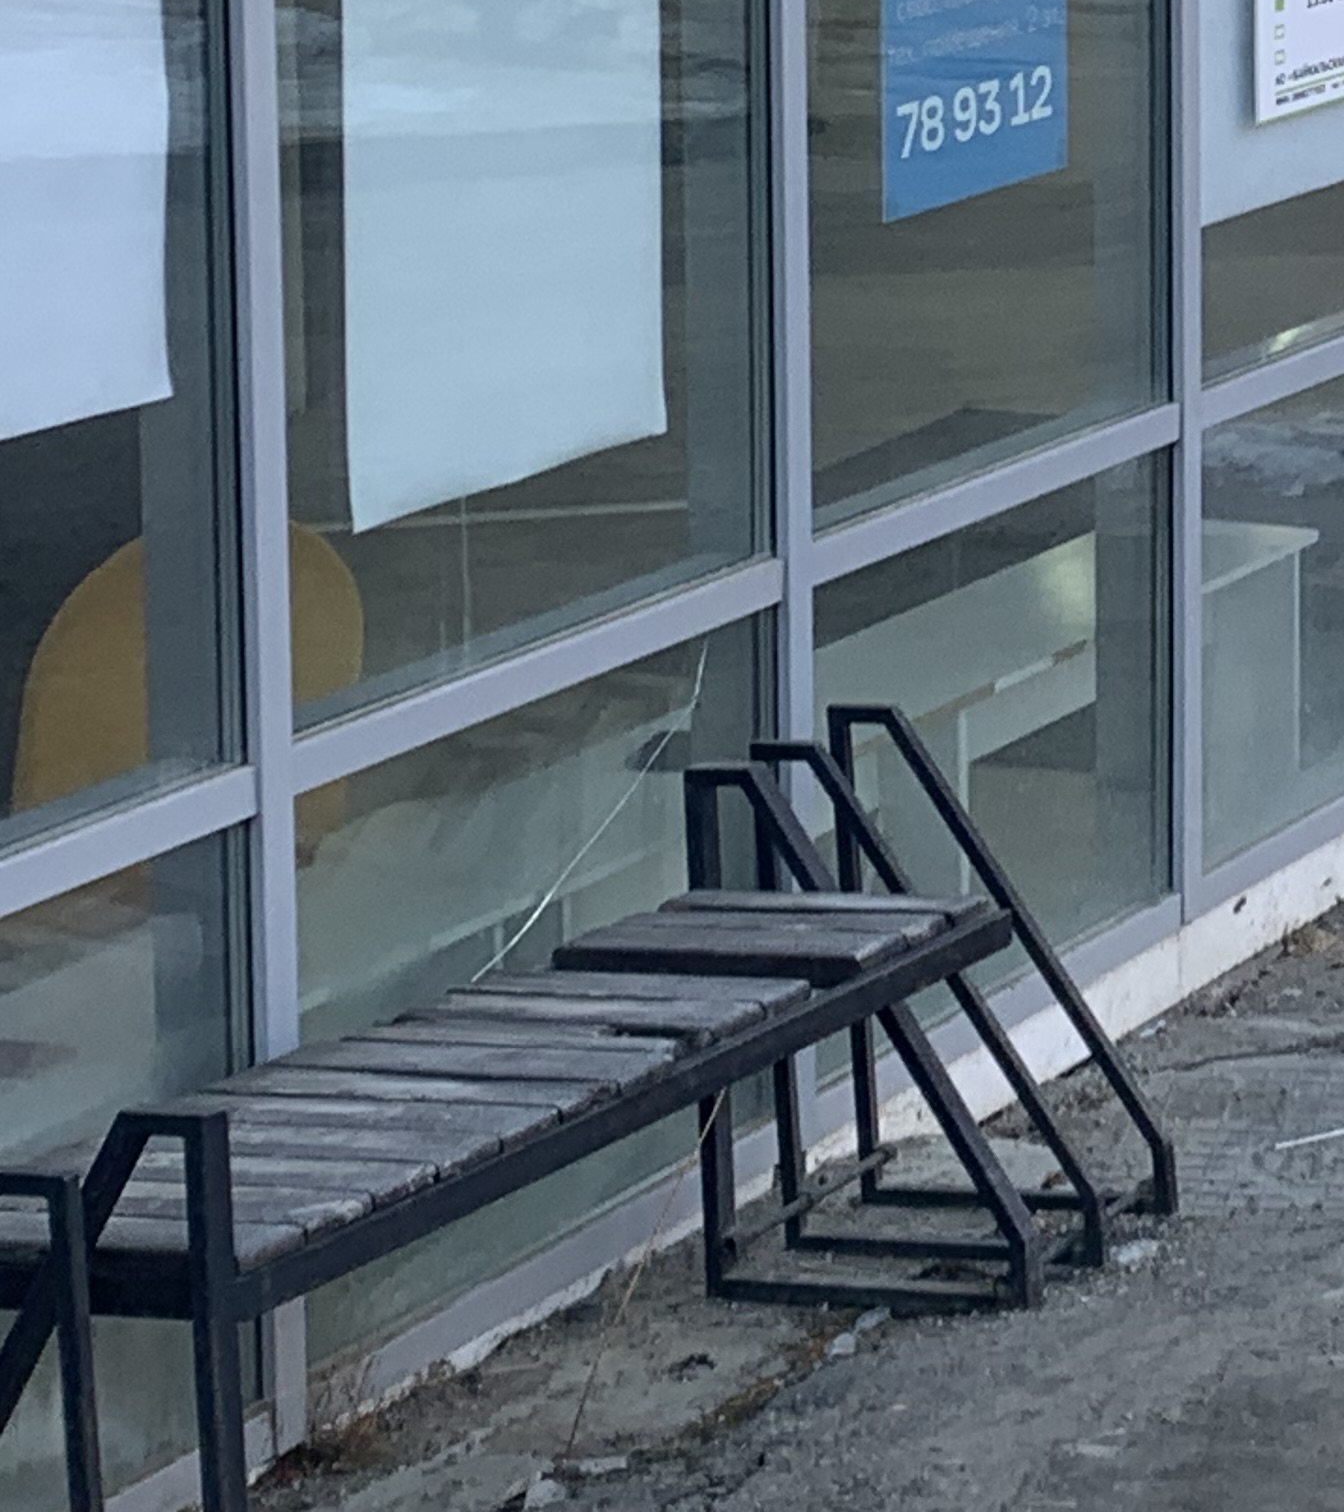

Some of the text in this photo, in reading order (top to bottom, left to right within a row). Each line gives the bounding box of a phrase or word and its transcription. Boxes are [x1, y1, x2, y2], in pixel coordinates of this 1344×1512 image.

[896, 65, 1054, 159] 78 93 12
